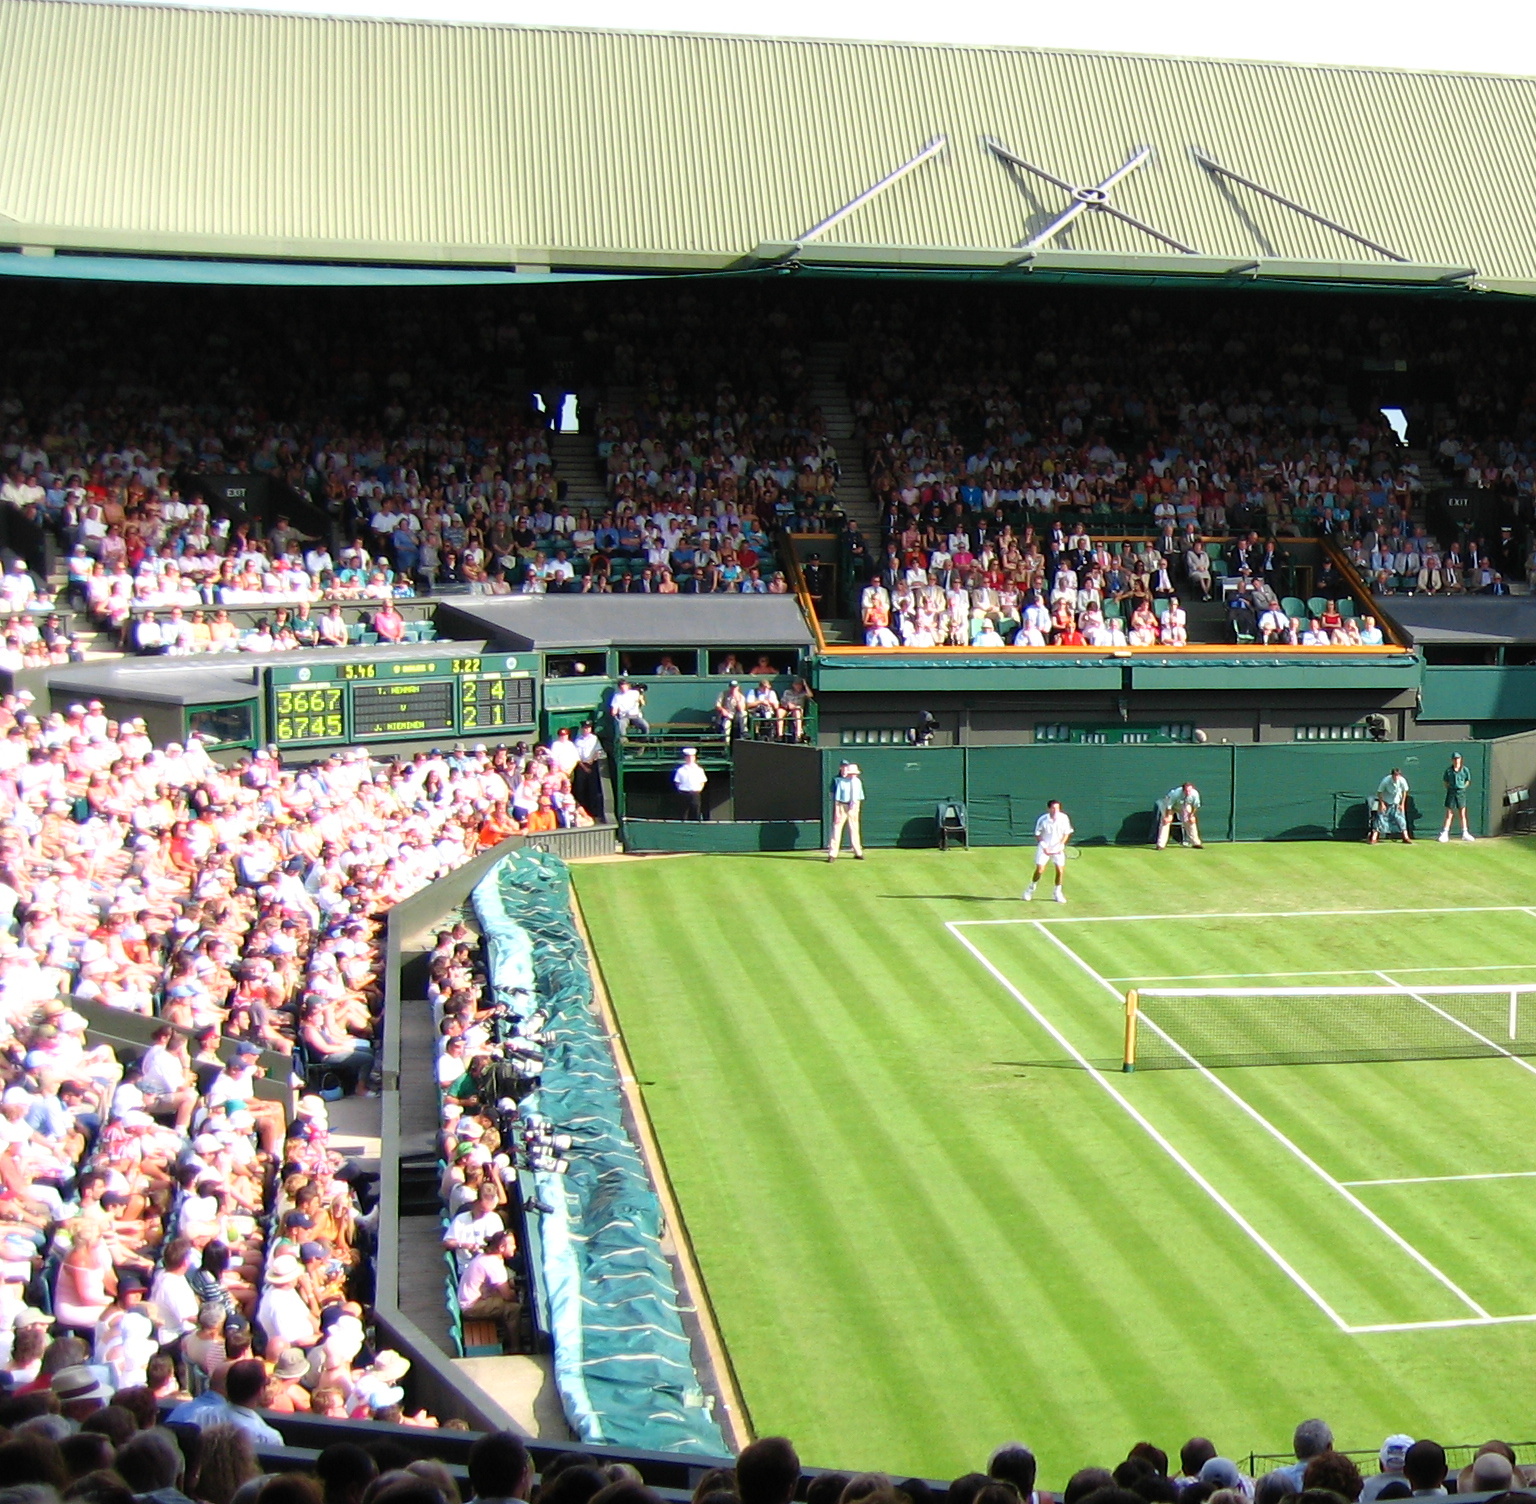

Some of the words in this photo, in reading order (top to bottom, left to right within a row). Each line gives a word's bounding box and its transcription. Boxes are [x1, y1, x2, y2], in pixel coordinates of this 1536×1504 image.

[227, 488, 246, 497] EXIT
[1448, 498, 1468, 506] EXIT
[452, 658, 481, 673] 3.22
[463, 681, 477, 702] 2
[491, 680, 505, 700] 4
[463, 705, 477, 727] 2
[493, 704, 503, 725] 1
